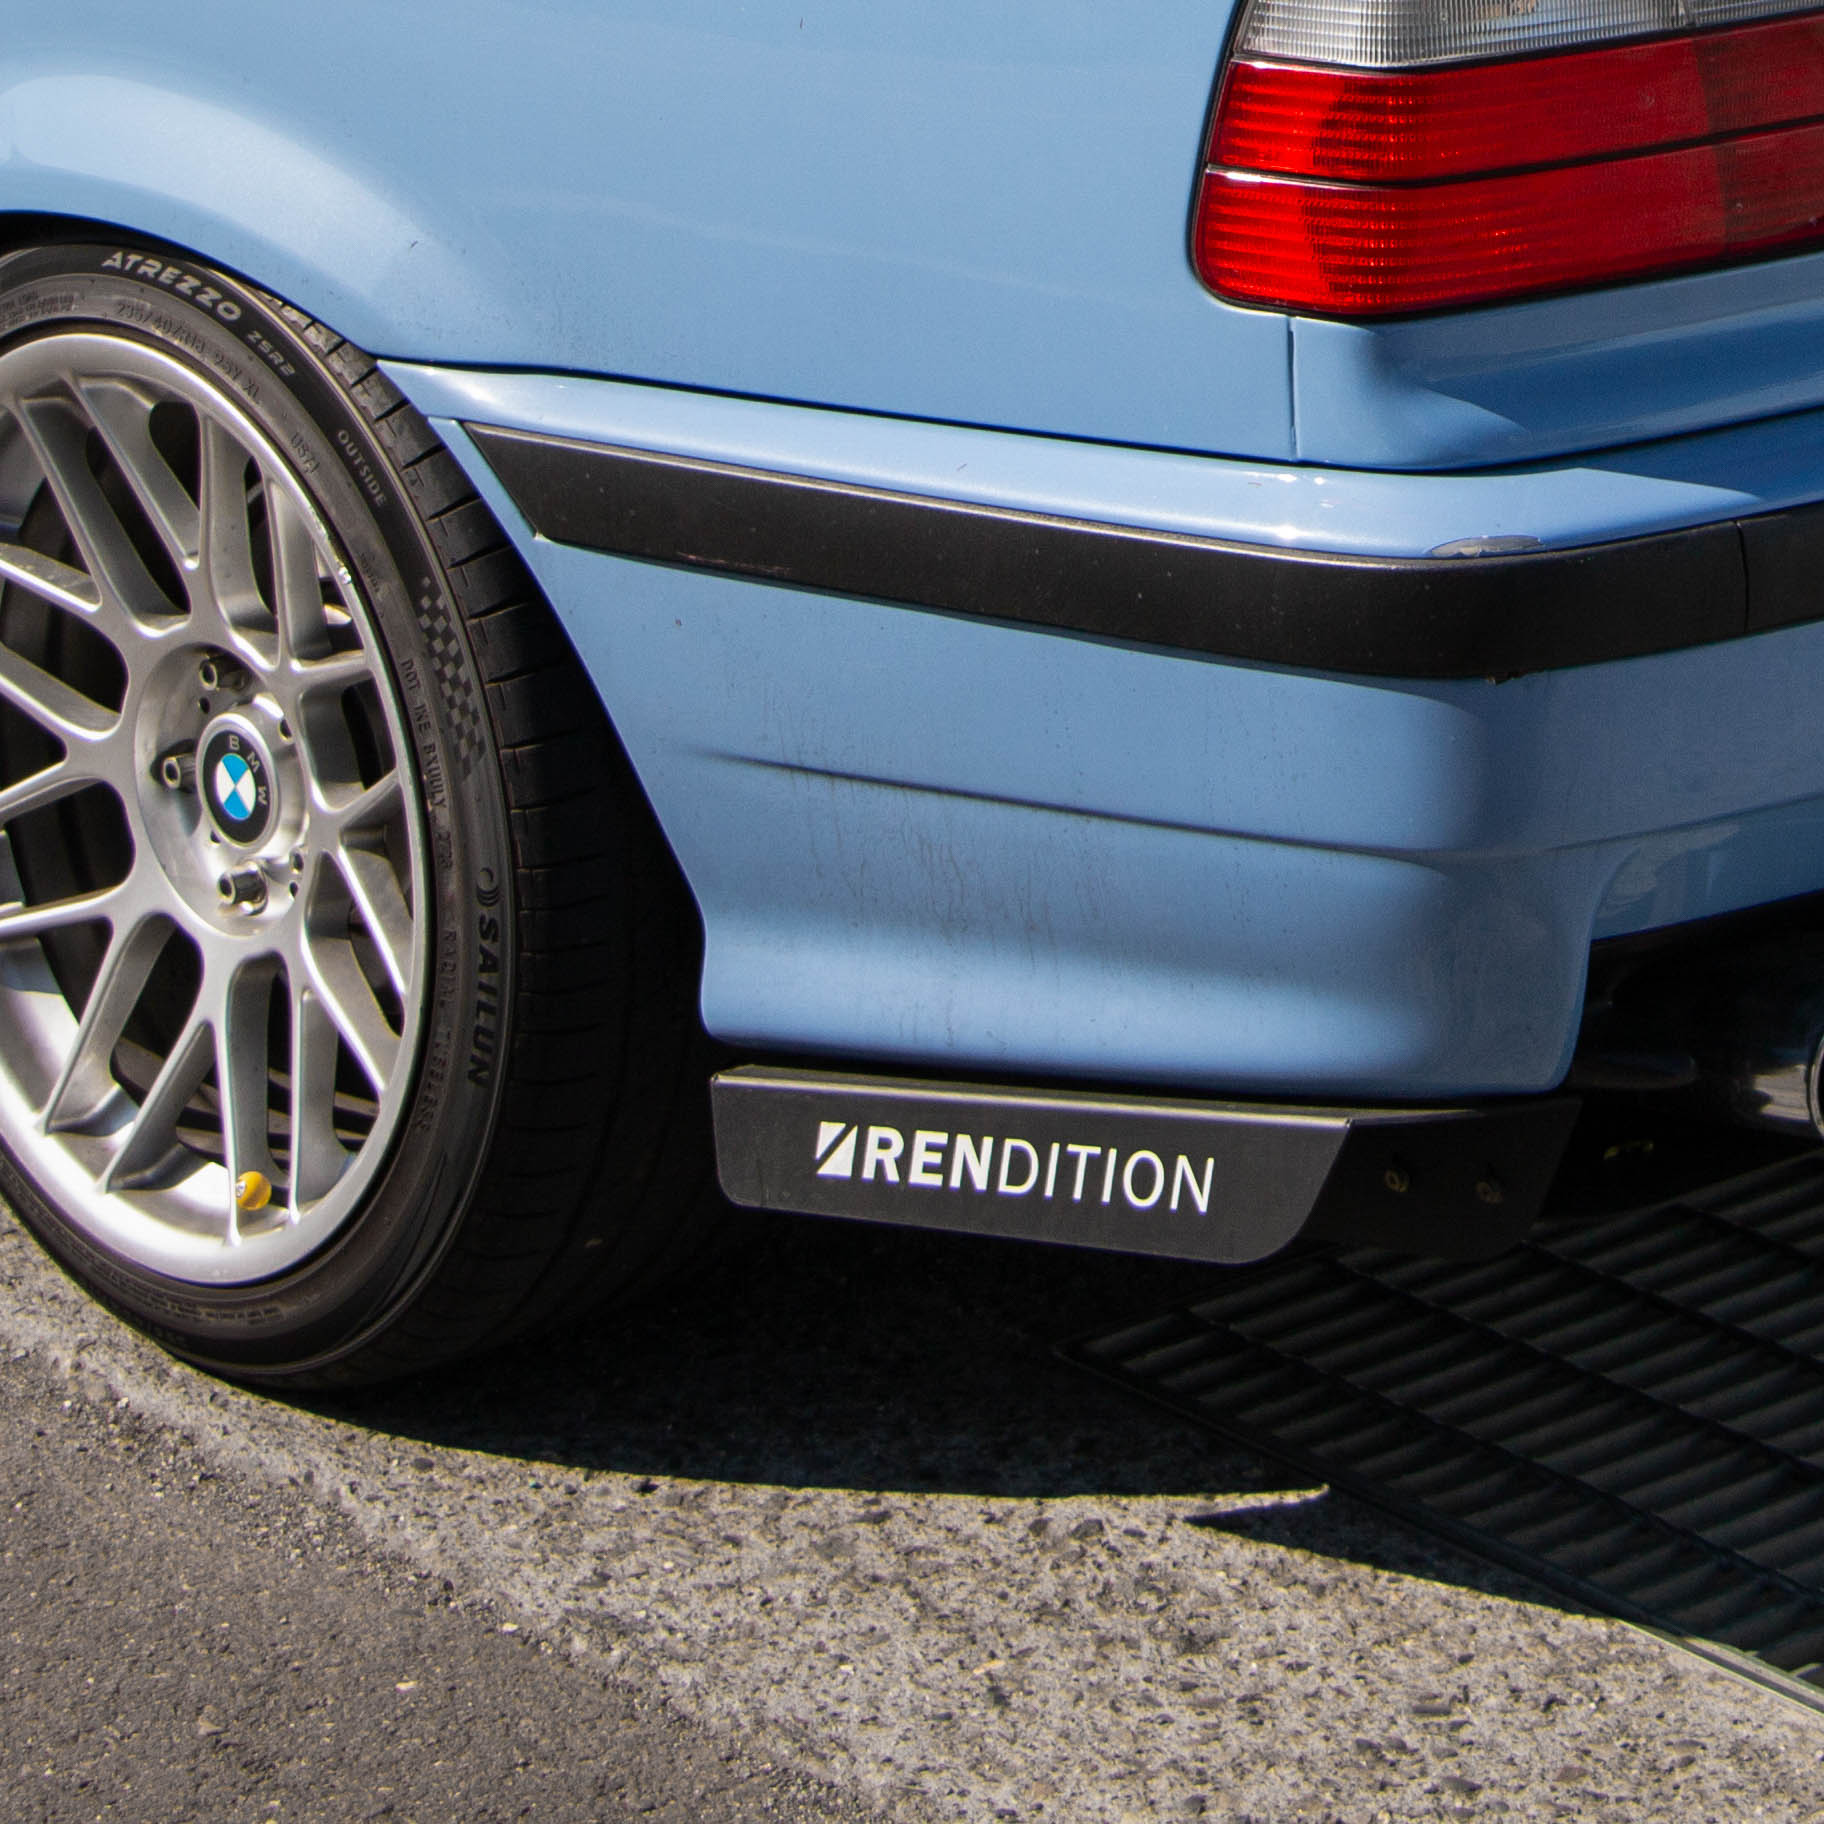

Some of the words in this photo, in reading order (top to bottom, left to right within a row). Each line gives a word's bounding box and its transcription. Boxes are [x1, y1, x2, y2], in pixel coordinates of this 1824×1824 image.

[101, 251, 242, 322] ATREZZO
[336, 428, 387, 507] OUTSIDE
[400, 657, 421, 691] DOT
[228, 733, 269, 806] BMW
[467, 913, 500, 1088] SAILUN
[861, 1125, 1215, 1214] RENDITION
